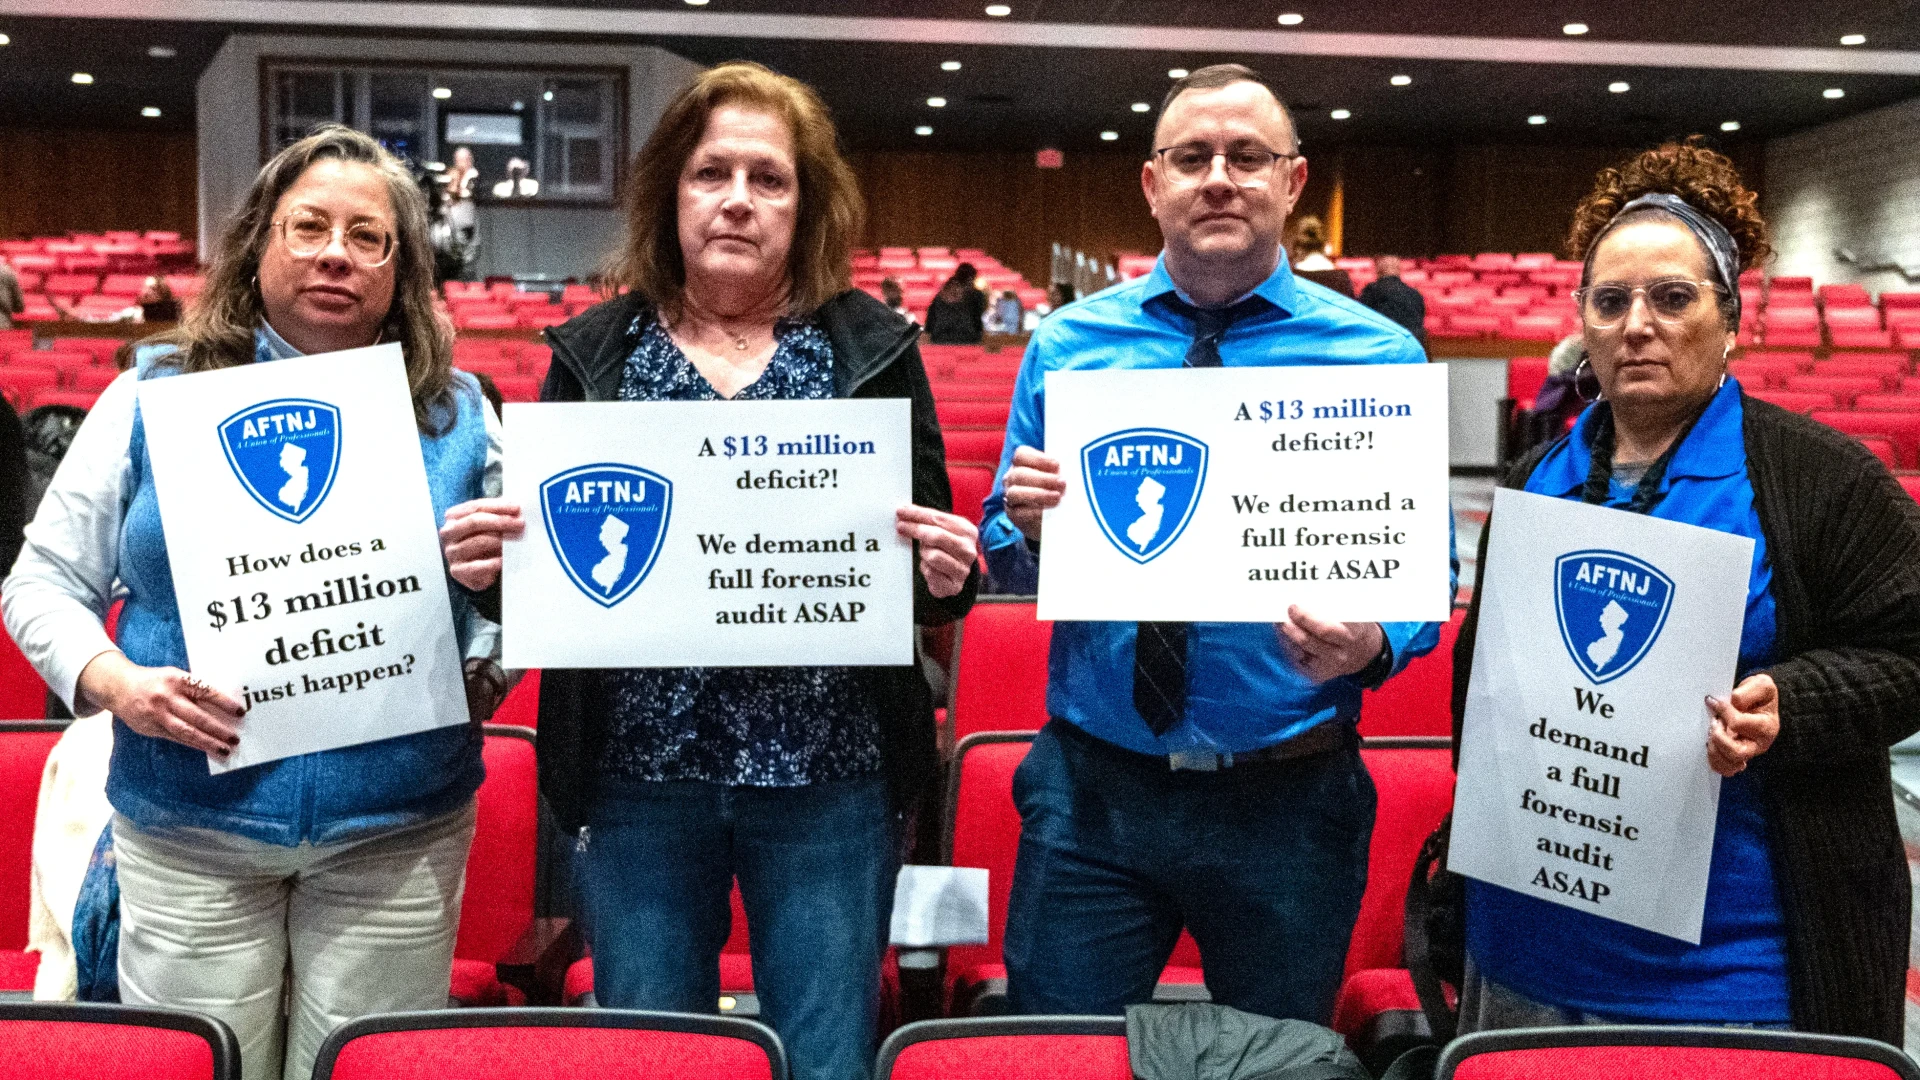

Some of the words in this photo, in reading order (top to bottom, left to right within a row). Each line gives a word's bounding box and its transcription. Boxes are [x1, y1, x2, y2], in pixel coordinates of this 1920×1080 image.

[1234, 402, 1252, 421] A
[1259, 399, 1304, 422] $13
[1313, 397, 1412, 419] million
[243, 409, 316, 439] AFTNJ
[698, 437, 716, 457] A
[723, 435, 768, 459] $13
[777, 433, 876, 456] million
[1271, 430, 1374, 452] deficit?!
[1104, 444, 1183, 467] AFTNJ
[565, 480, 646, 503] AFTNJ
[736, 468, 838, 490] deficit?!
[565, 504, 590, 513] Union
[592, 504, 601, 515] of
[603, 503, 659, 513] Professionals
[1231, 494, 1270, 514] We
[1279, 491, 1391, 513] demand
[1401, 498, 1415, 511] a
[696, 533, 737, 555] We
[745, 531, 857, 554] demand
[865, 538, 880, 553] a
[1242, 527, 1286, 548] full
[1295, 525, 1406, 547] forensic
[226, 554, 291, 577] How
[299, 541, 363, 565] does
[370, 538, 386, 552] a
[1248, 560, 1318, 581] audit
[1327, 559, 1400, 580] ASAP
[708, 568, 753, 590] full
[761, 566, 871, 589] forensic
[1576, 562, 1650, 595] AFTNJ
[206, 591, 272, 632] $13
[284, 573, 422, 615] million
[715, 602, 786, 625] audit
[793, 601, 866, 623] ASAP
[265, 621, 385, 666] deficit
[242, 680, 297, 713] just
[301, 653, 417, 694] happen?
[1574, 686, 1615, 719] We
[1528, 717, 1650, 769] demand
[1546, 766, 1563, 783] a
[1570, 766, 1621, 800] full
[1518, 788, 1640, 842] forensic
[1536, 836, 1615, 872] audit
[1530, 865, 1612, 905] ASAP
